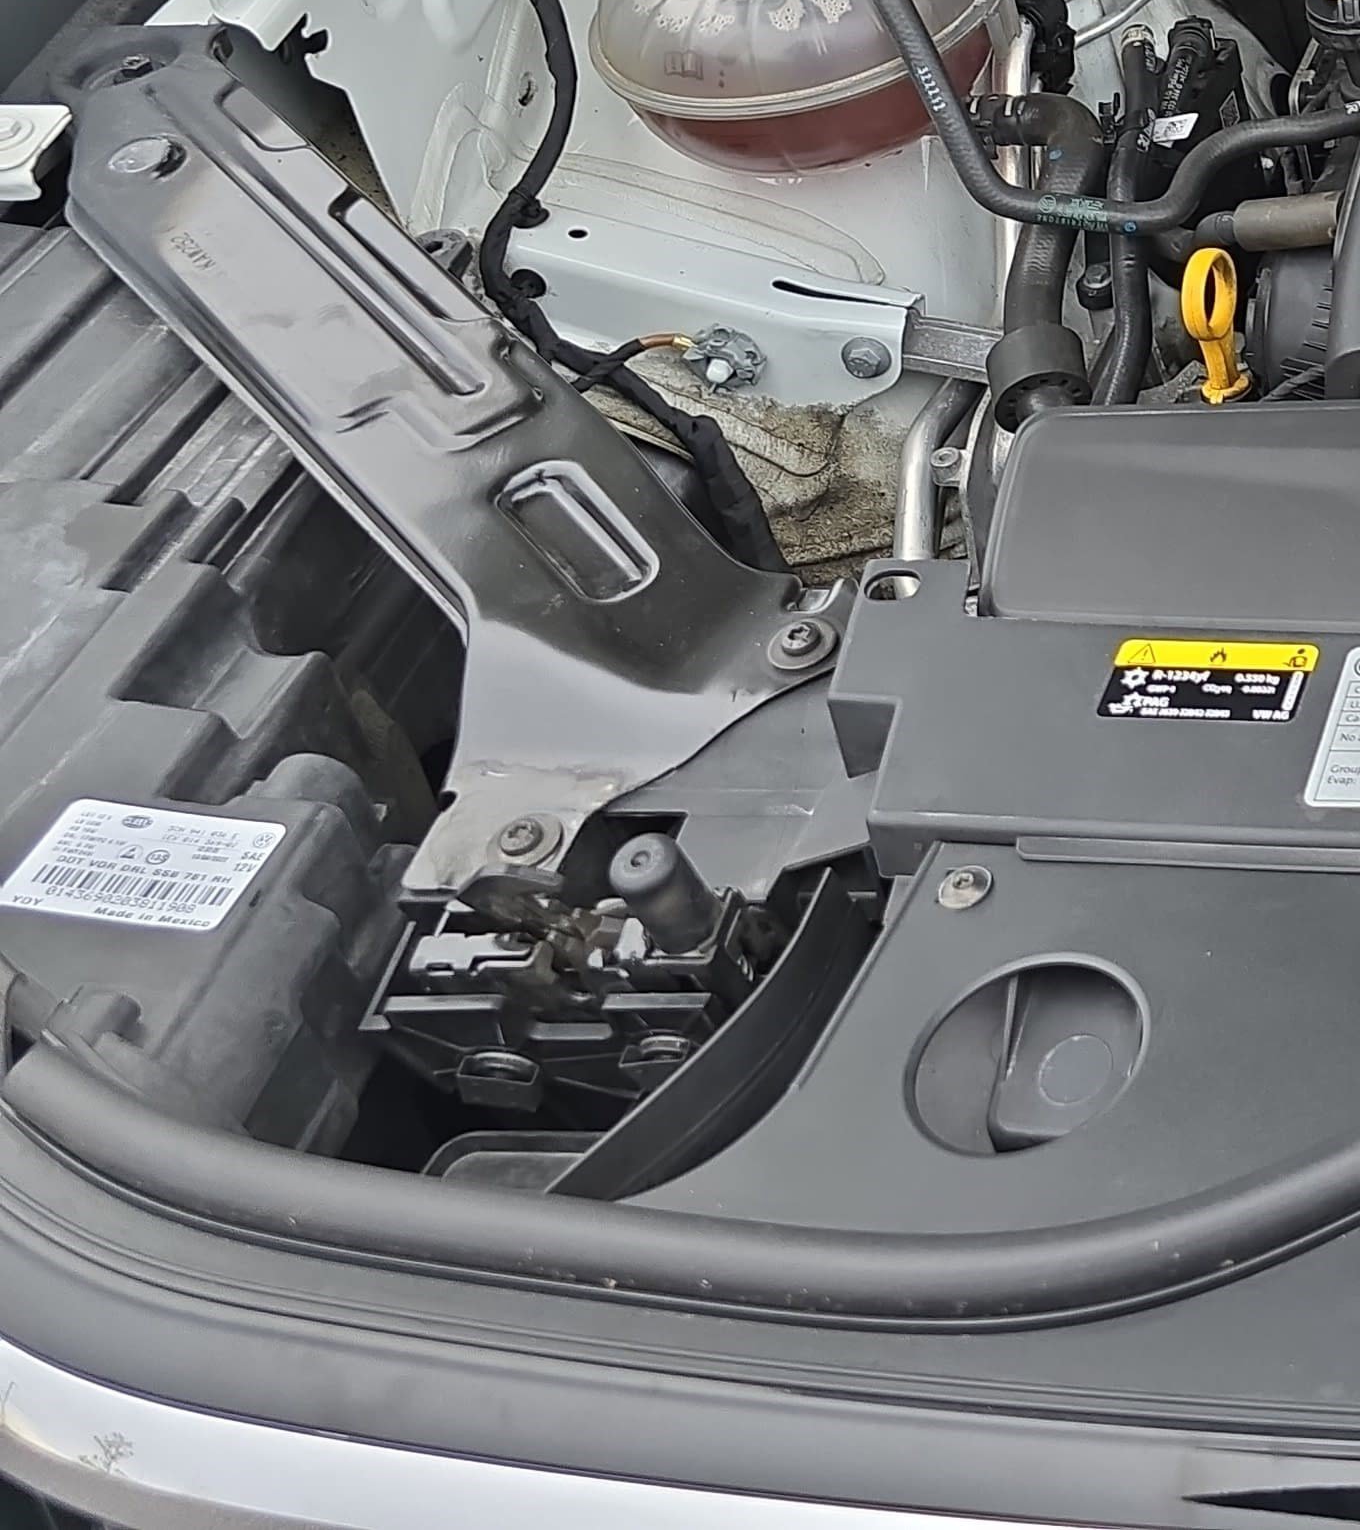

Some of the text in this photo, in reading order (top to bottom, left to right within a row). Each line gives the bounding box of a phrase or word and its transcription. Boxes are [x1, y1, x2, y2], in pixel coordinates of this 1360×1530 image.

[1340, 733, 1356, 742] No
[1327, 775, 1357, 786] Evap:
[92, 906, 135, 918] Made
[157, 914, 213, 927] Mexico
